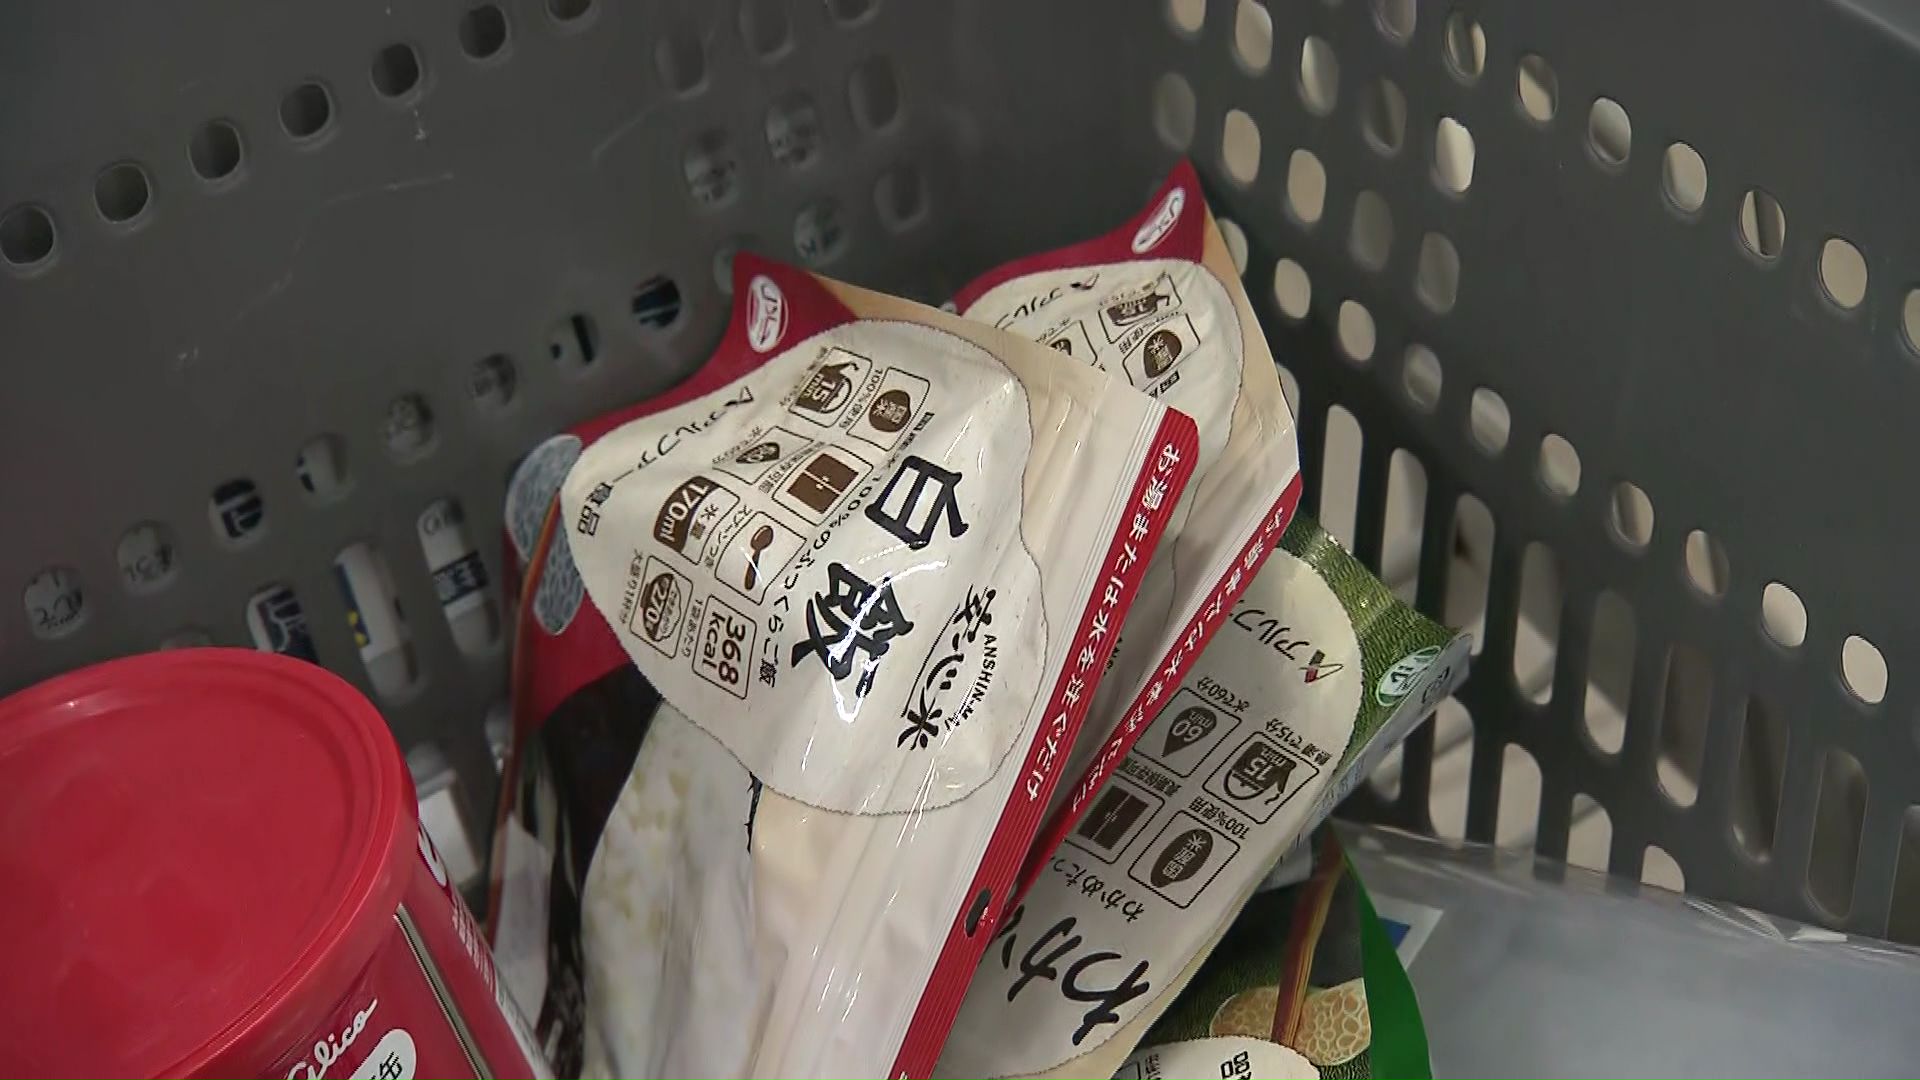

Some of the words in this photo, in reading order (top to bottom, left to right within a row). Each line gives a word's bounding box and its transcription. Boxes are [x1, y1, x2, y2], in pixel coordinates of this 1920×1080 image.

[661, 480, 711, 543] 170ml
[791, 454, 970, 700] 白飯
[702, 612, 725, 670] kcal
[718, 616, 746, 686] 368
[1027, 440, 1182, 801] お湯または水を注ぐだけ
[897, 584, 998, 750] 安心米
[1197, 676, 1251, 714] 水で60分
[1173, 720, 1204, 743] 60
[1243, 757, 1270, 781] 15
[1188, 795, 1252, 841] 100%使用
[1050, 855, 1147, 923] わかめたっ
[1001, 904, 1151, 1046] わか
